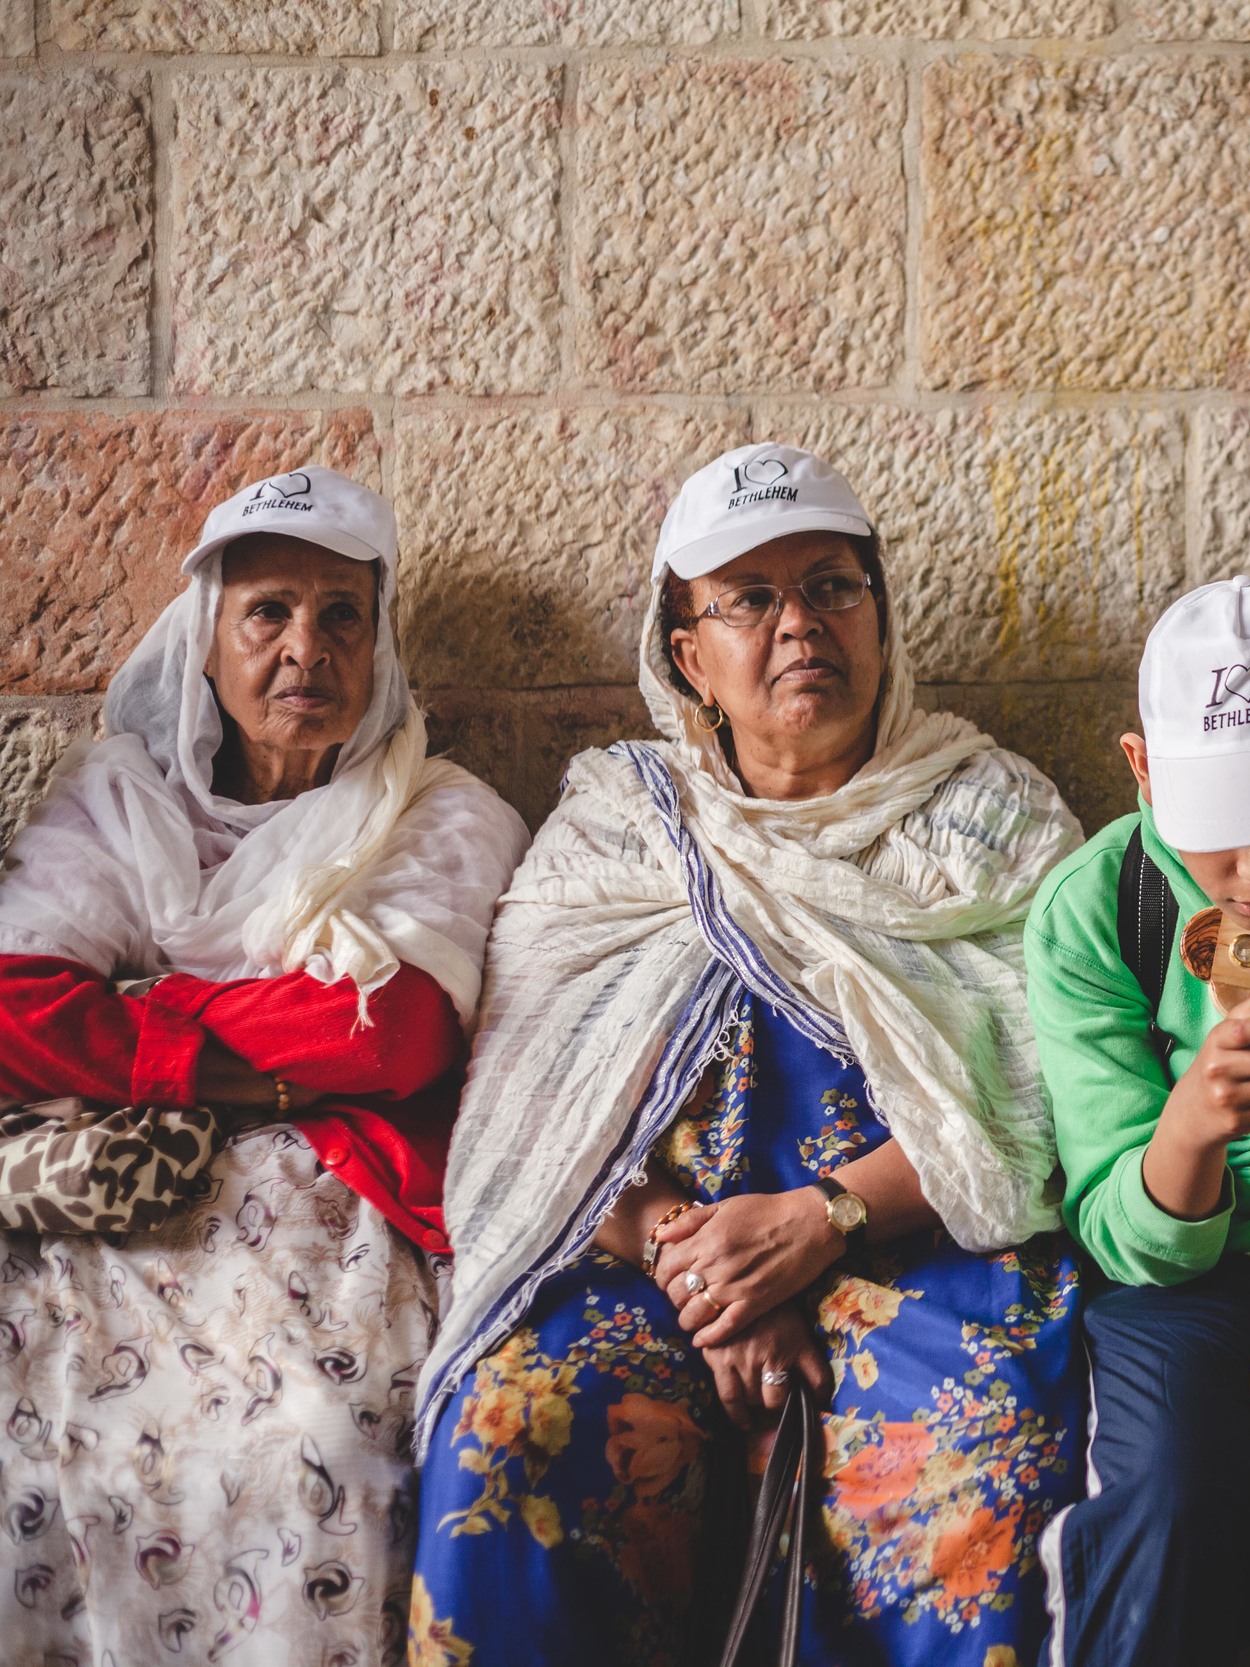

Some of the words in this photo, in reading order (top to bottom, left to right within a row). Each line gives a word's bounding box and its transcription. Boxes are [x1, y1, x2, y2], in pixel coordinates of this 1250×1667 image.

[732, 464, 747, 494] I
[242, 499, 314, 517] BETHLEHEM
[728, 485, 798, 509] BETHLEHEM
[1205, 666, 1228, 708] I
